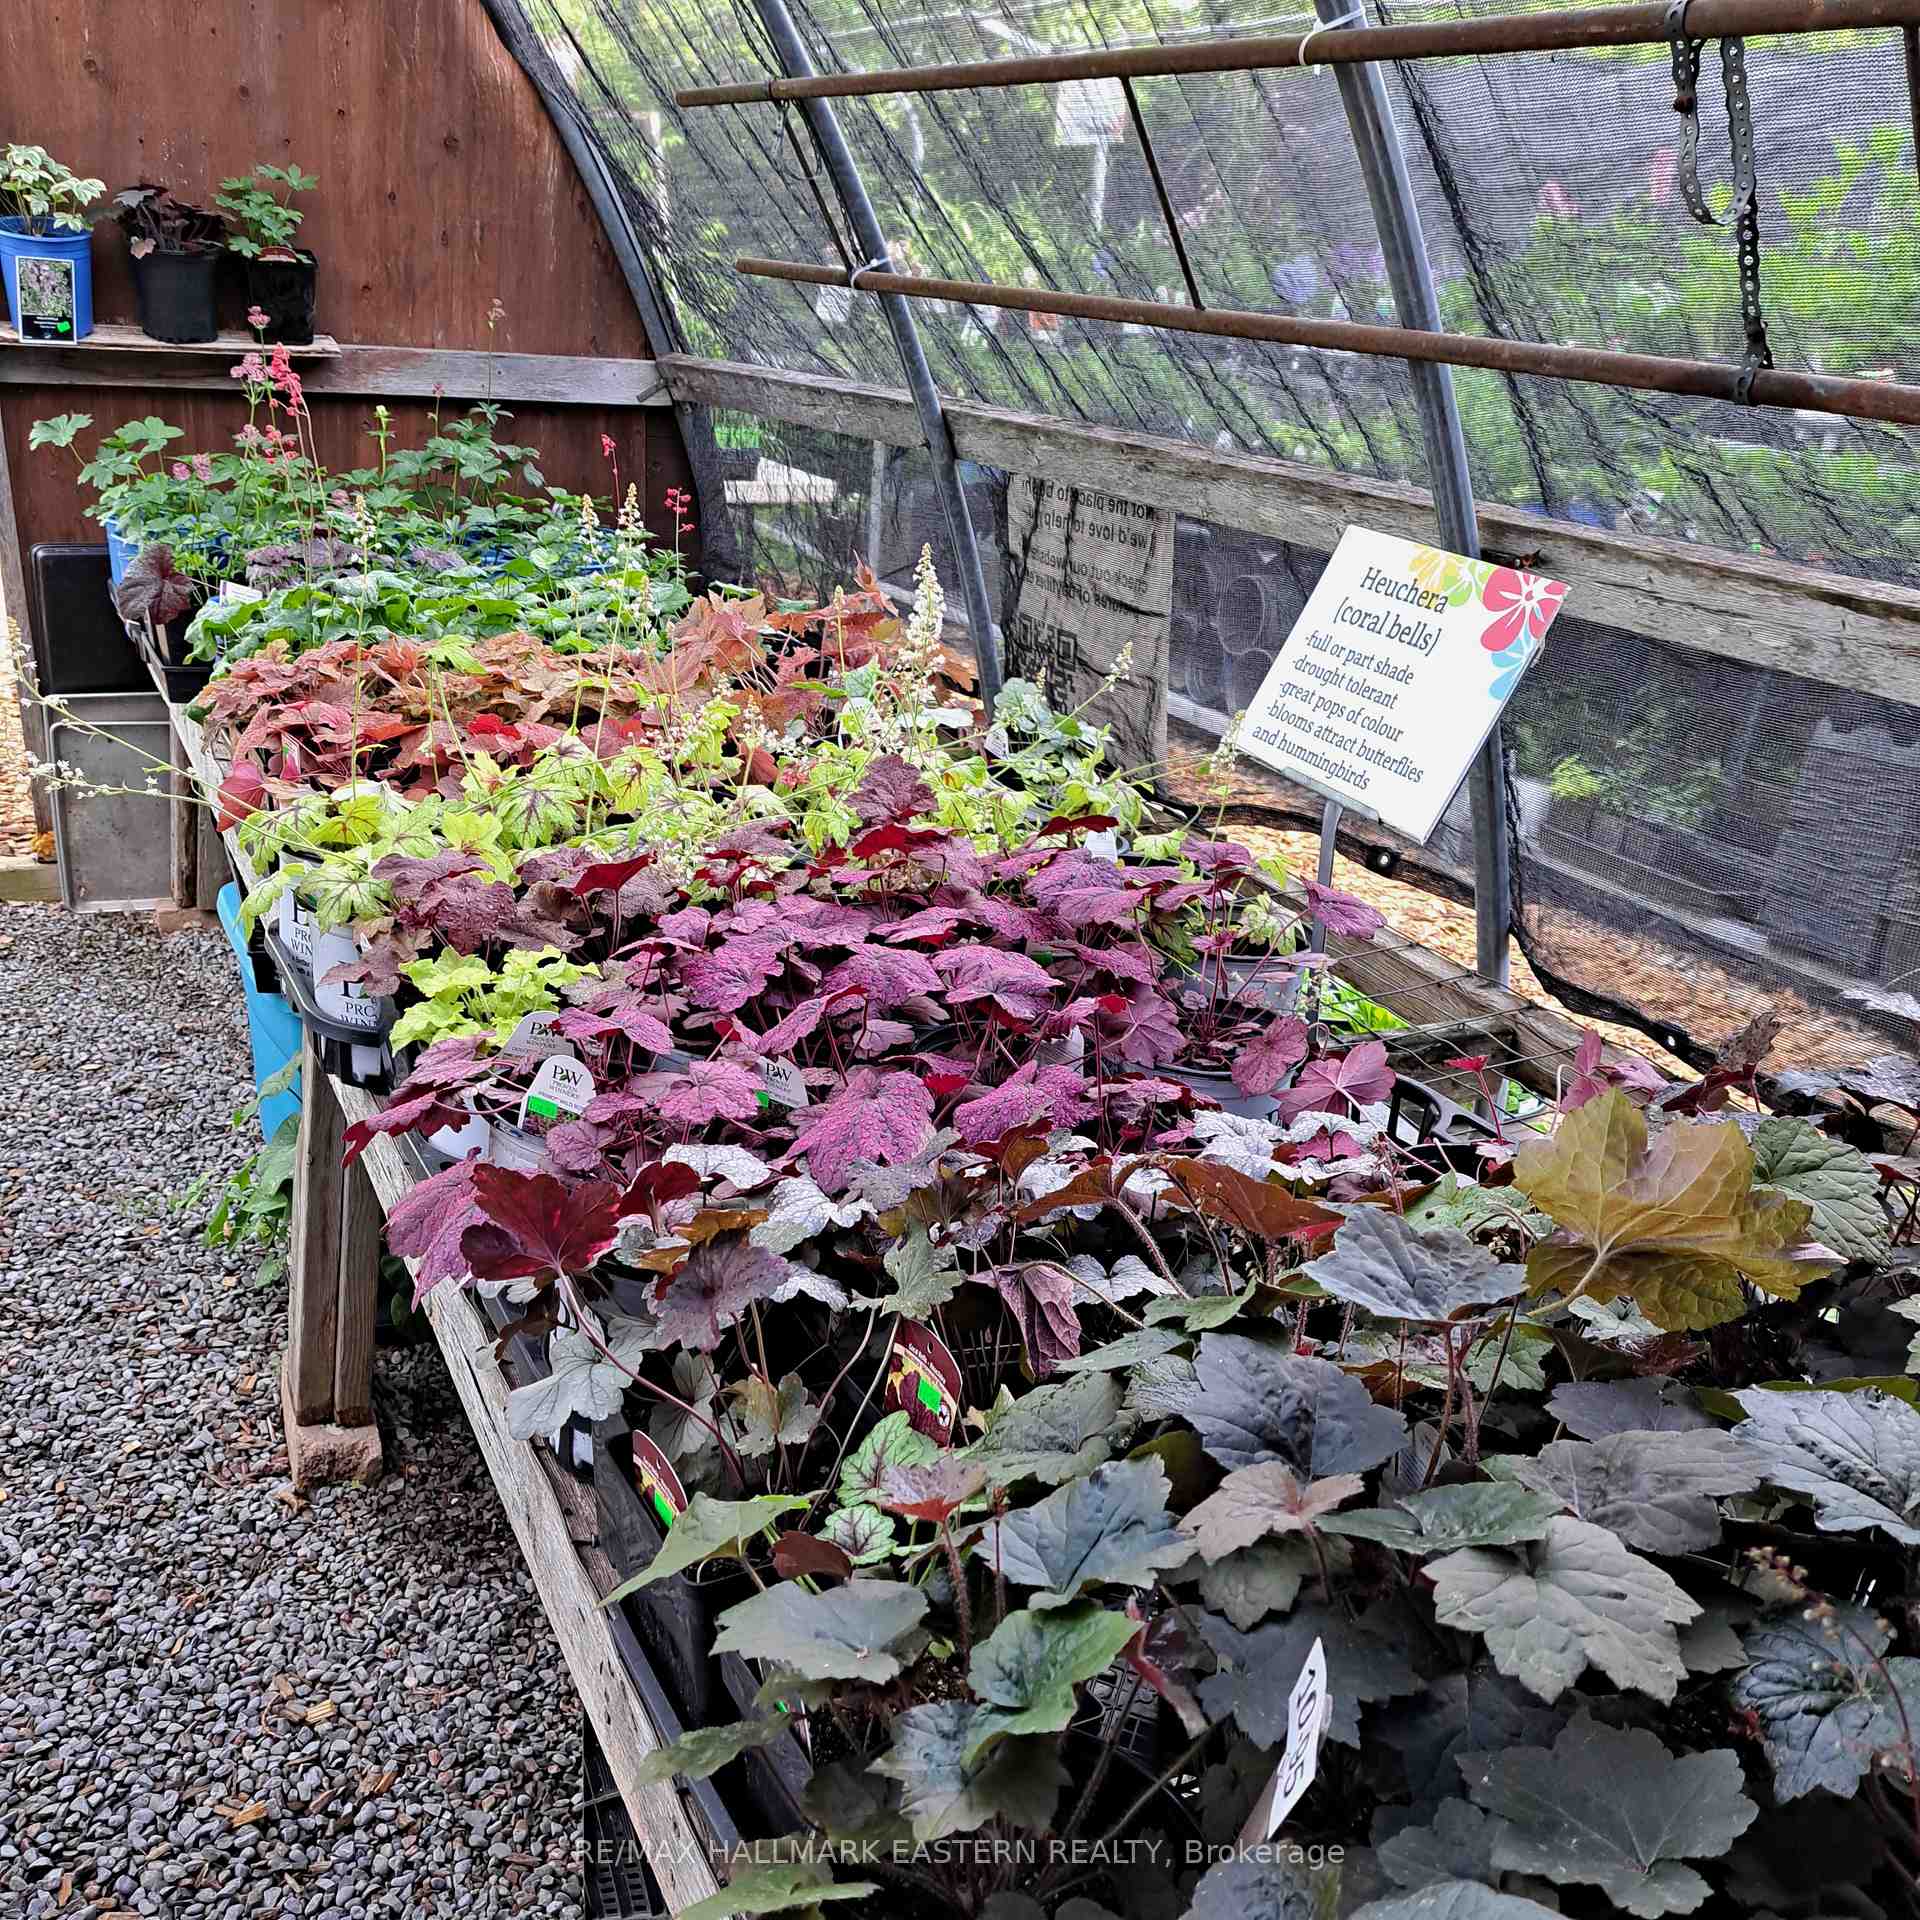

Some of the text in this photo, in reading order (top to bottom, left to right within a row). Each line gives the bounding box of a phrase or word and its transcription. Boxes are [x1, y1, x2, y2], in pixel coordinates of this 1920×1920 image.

[1360, 566, 1449, 614] Heuchera
[1292, 654, 1399, 710] -drought tolerant
[1305, 630, 1415, 685] -full or part shade
[1280, 681, 1405, 742] -great pops of colour
[1252, 725, 1372, 791] and hummingbirds
[1266, 700, 1425, 784] -blooms attract butterflies
